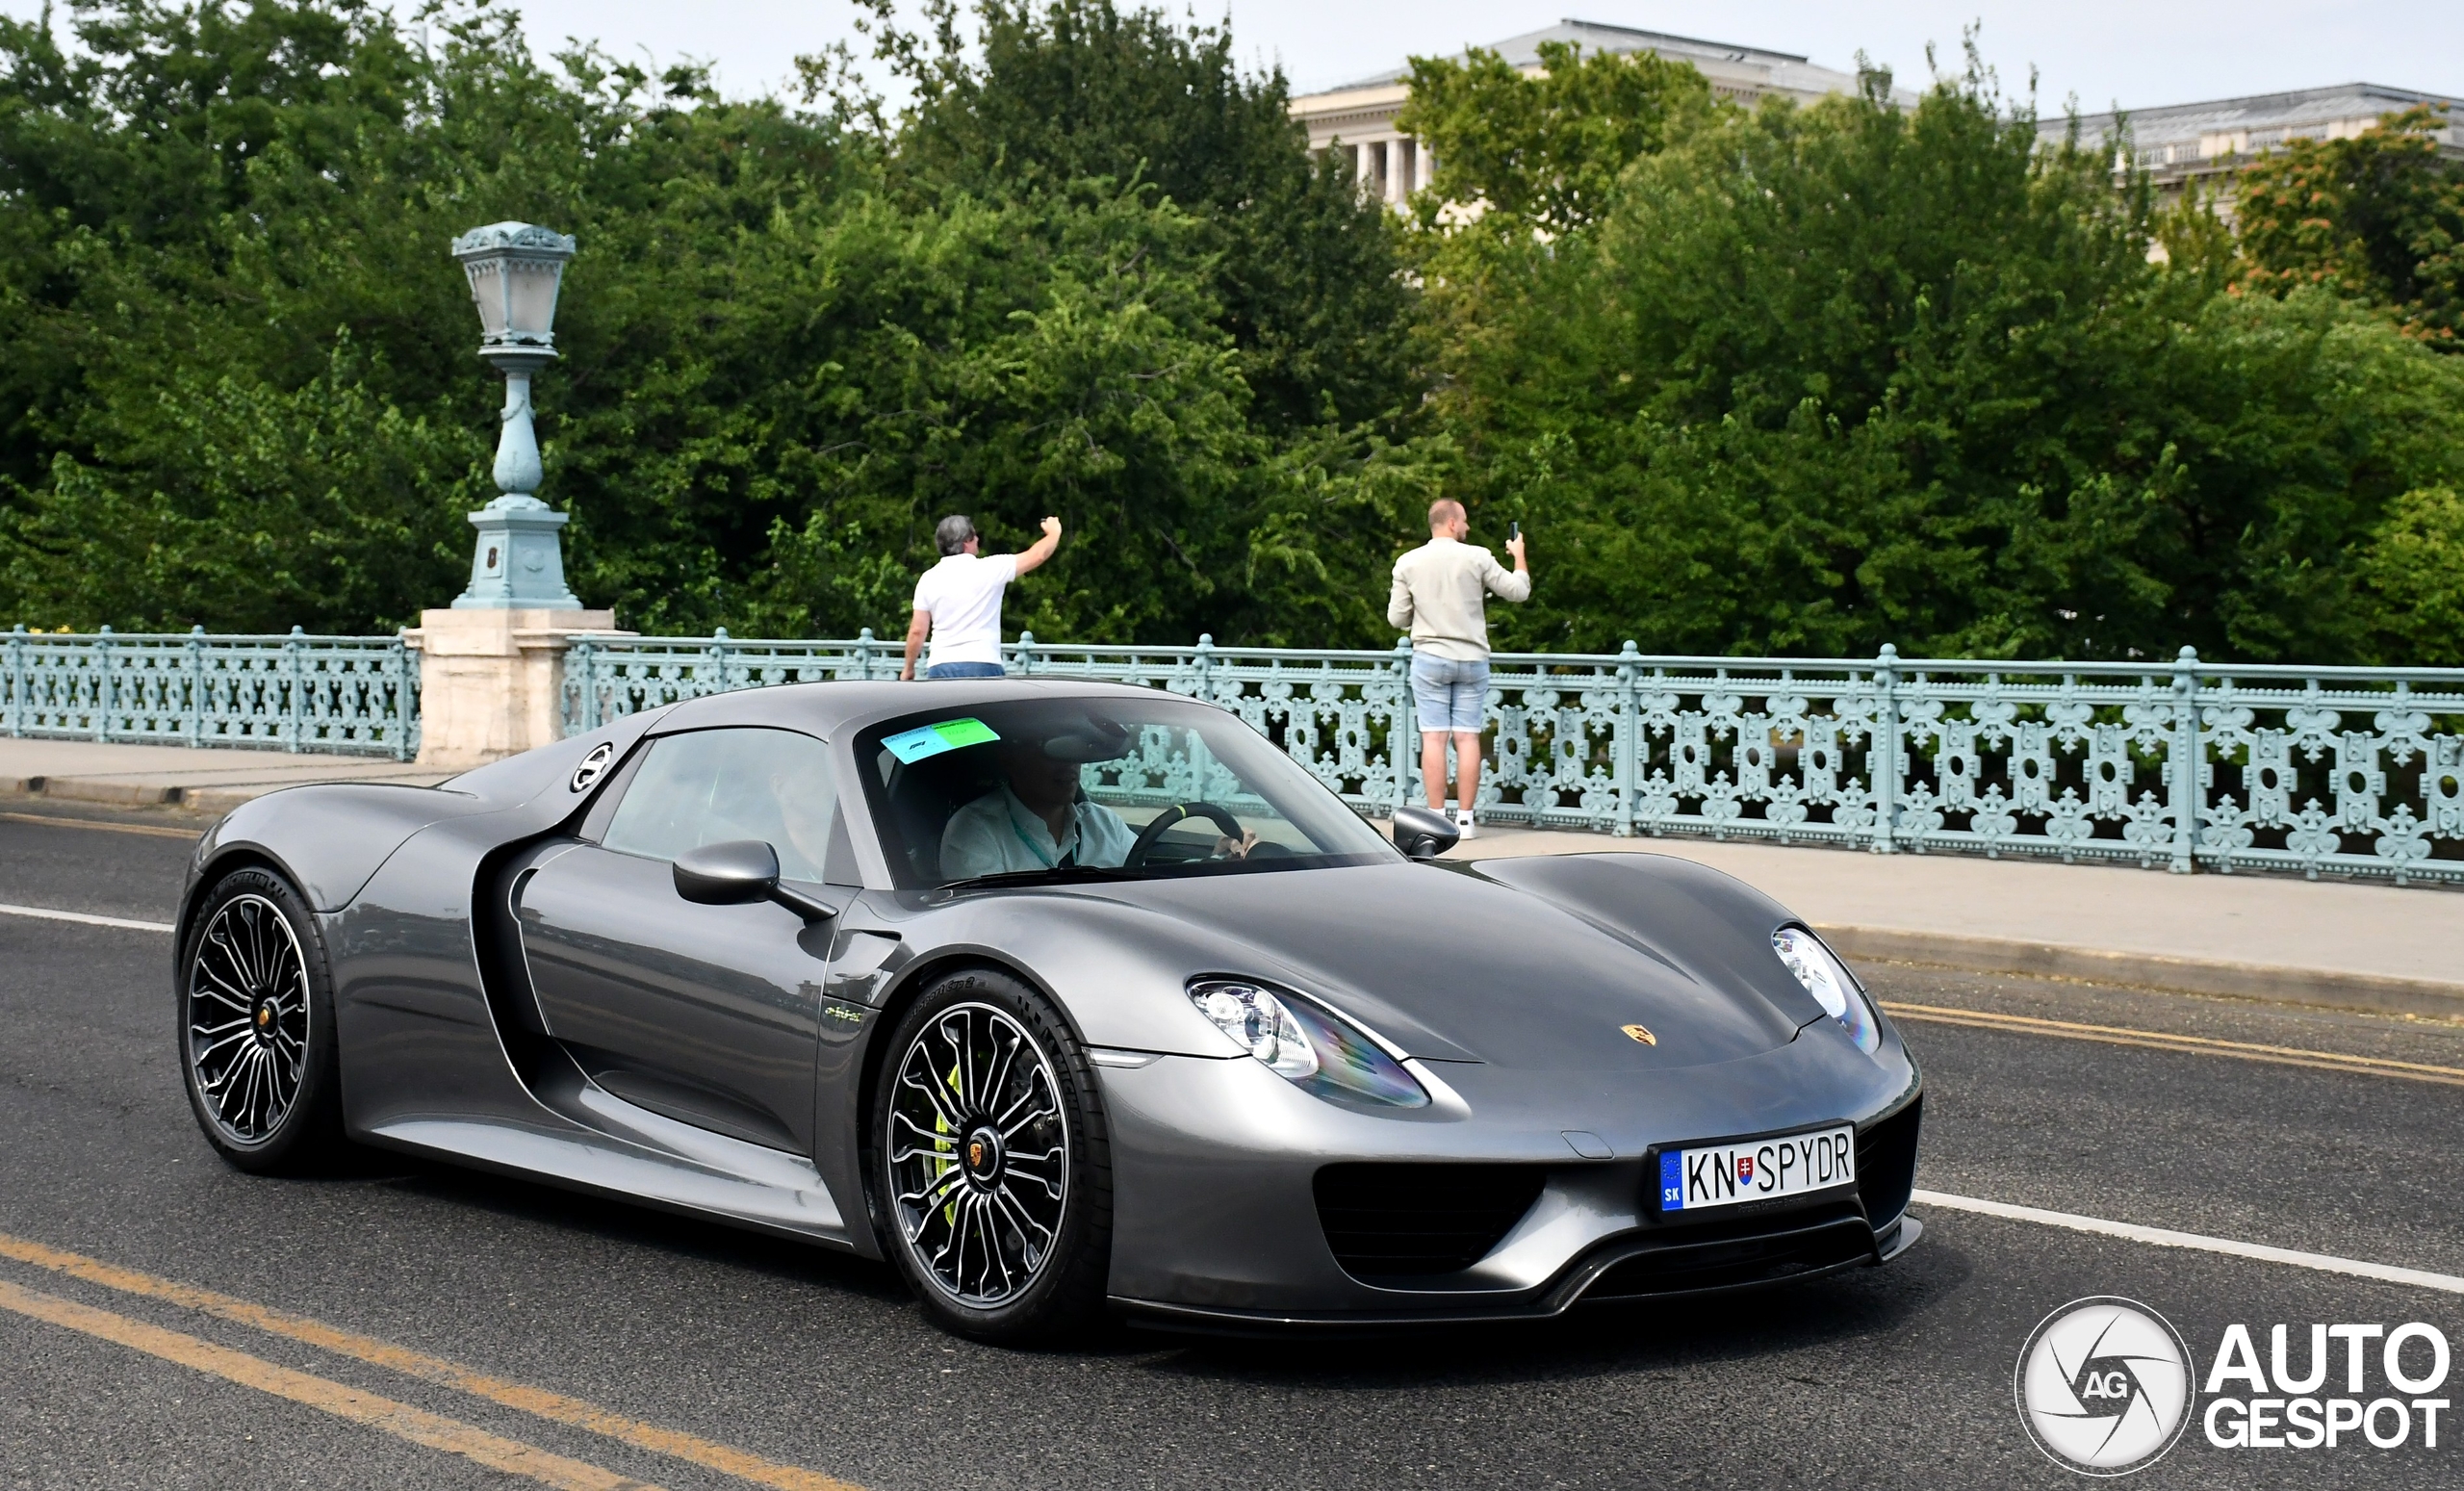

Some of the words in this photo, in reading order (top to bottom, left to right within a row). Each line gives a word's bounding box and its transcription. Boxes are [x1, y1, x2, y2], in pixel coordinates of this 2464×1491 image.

[218, 871, 270, 895] MICHELIN
[918, 985, 945, 1011] Sport
[945, 979, 963, 992] Cup
[964, 976, 975, 989] 2
[1051, 1053, 1085, 1164] MICHELIN
[1687, 1150, 1735, 1202] KN
[1757, 1132, 1850, 1193] SPYDR
[1664, 1187, 1680, 1202] SK
